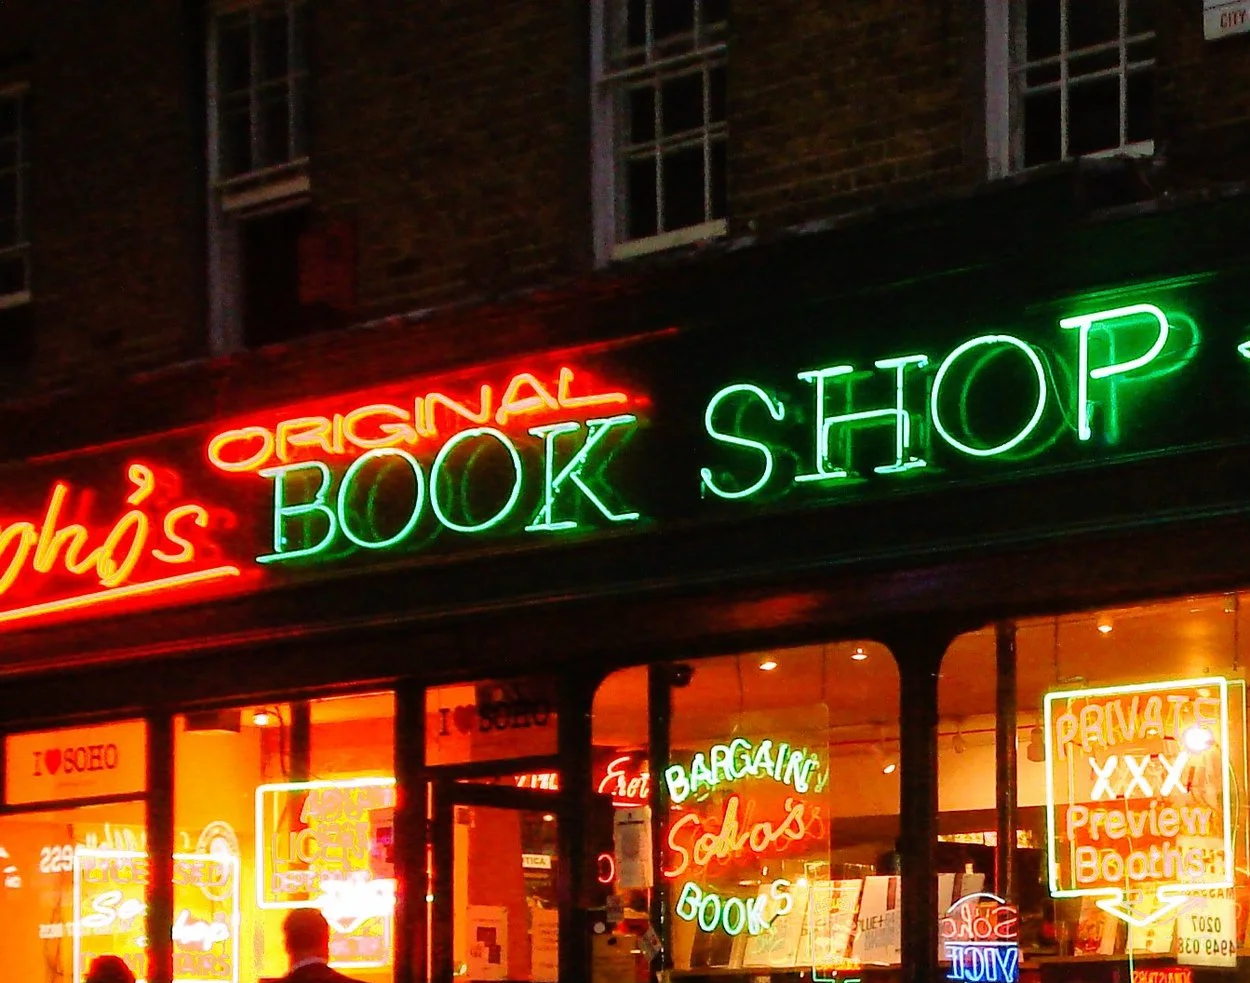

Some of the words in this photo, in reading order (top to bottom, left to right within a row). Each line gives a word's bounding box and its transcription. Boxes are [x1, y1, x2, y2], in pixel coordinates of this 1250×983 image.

[1220, 11, 1247, 29] CITY
[208, 367, 627, 472] ORIGINAL
[256, 413, 639, 564] BOOK
[700, 303, 1170, 499] SHOP
[1055, 694, 1221, 761] PRIVATE
[32, 751, 43, 777] I
[63, 743, 119, 774] SOHO
[665, 738, 809, 804] BARGAIN
[1088, 751, 1190, 801] XXX
[664, 796, 807, 878] Soho's
[1066, 800, 1213, 842] Preview
[1076, 842, 1206, 884] Booths
[676, 879, 794, 936] BOOKS
